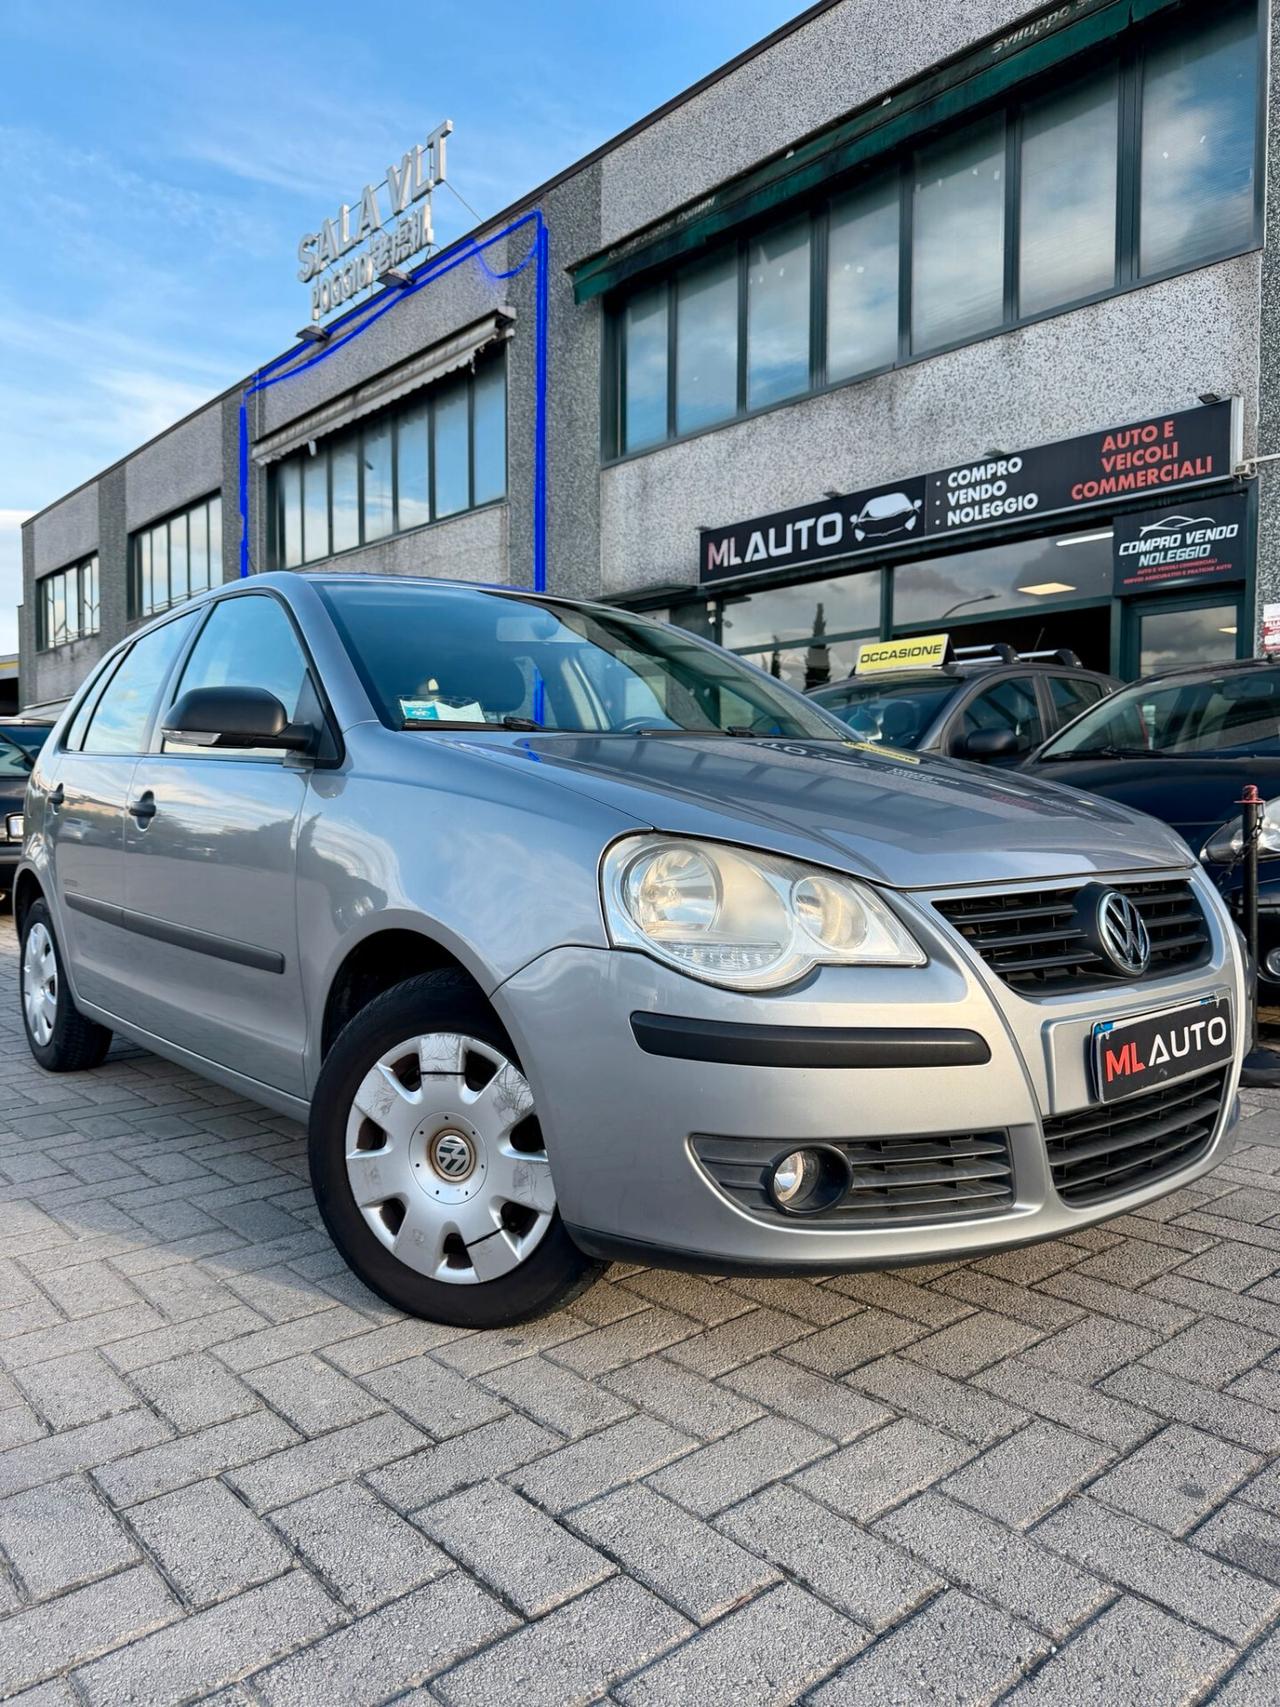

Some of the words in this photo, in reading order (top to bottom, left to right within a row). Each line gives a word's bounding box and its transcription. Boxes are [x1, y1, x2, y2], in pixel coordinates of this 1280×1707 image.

[298, 184, 381, 283] SALA
[386, 119, 453, 216] VLT
[311, 252, 374, 320] POGGIO
[1102, 426, 1158, 453] AUTO
[1164, 421, 1175, 438] E
[947, 456, 1023, 488] COMPRO
[1101, 441, 1178, 473] VEICOLI
[947, 480, 1007, 507] VENDO
[1071, 456, 1212, 500] COMMERCIALI
[947, 493, 1038, 527] NOLEGGIO
[1119, 534, 1182, 556] COMPRO
[1186, 524, 1239, 545] VENDO
[1138, 544, 1211, 567] NOLEGGIO
[860, 644, 943, 663] OCCASIONE
[1148, 1016, 1227, 1067] AUTO
